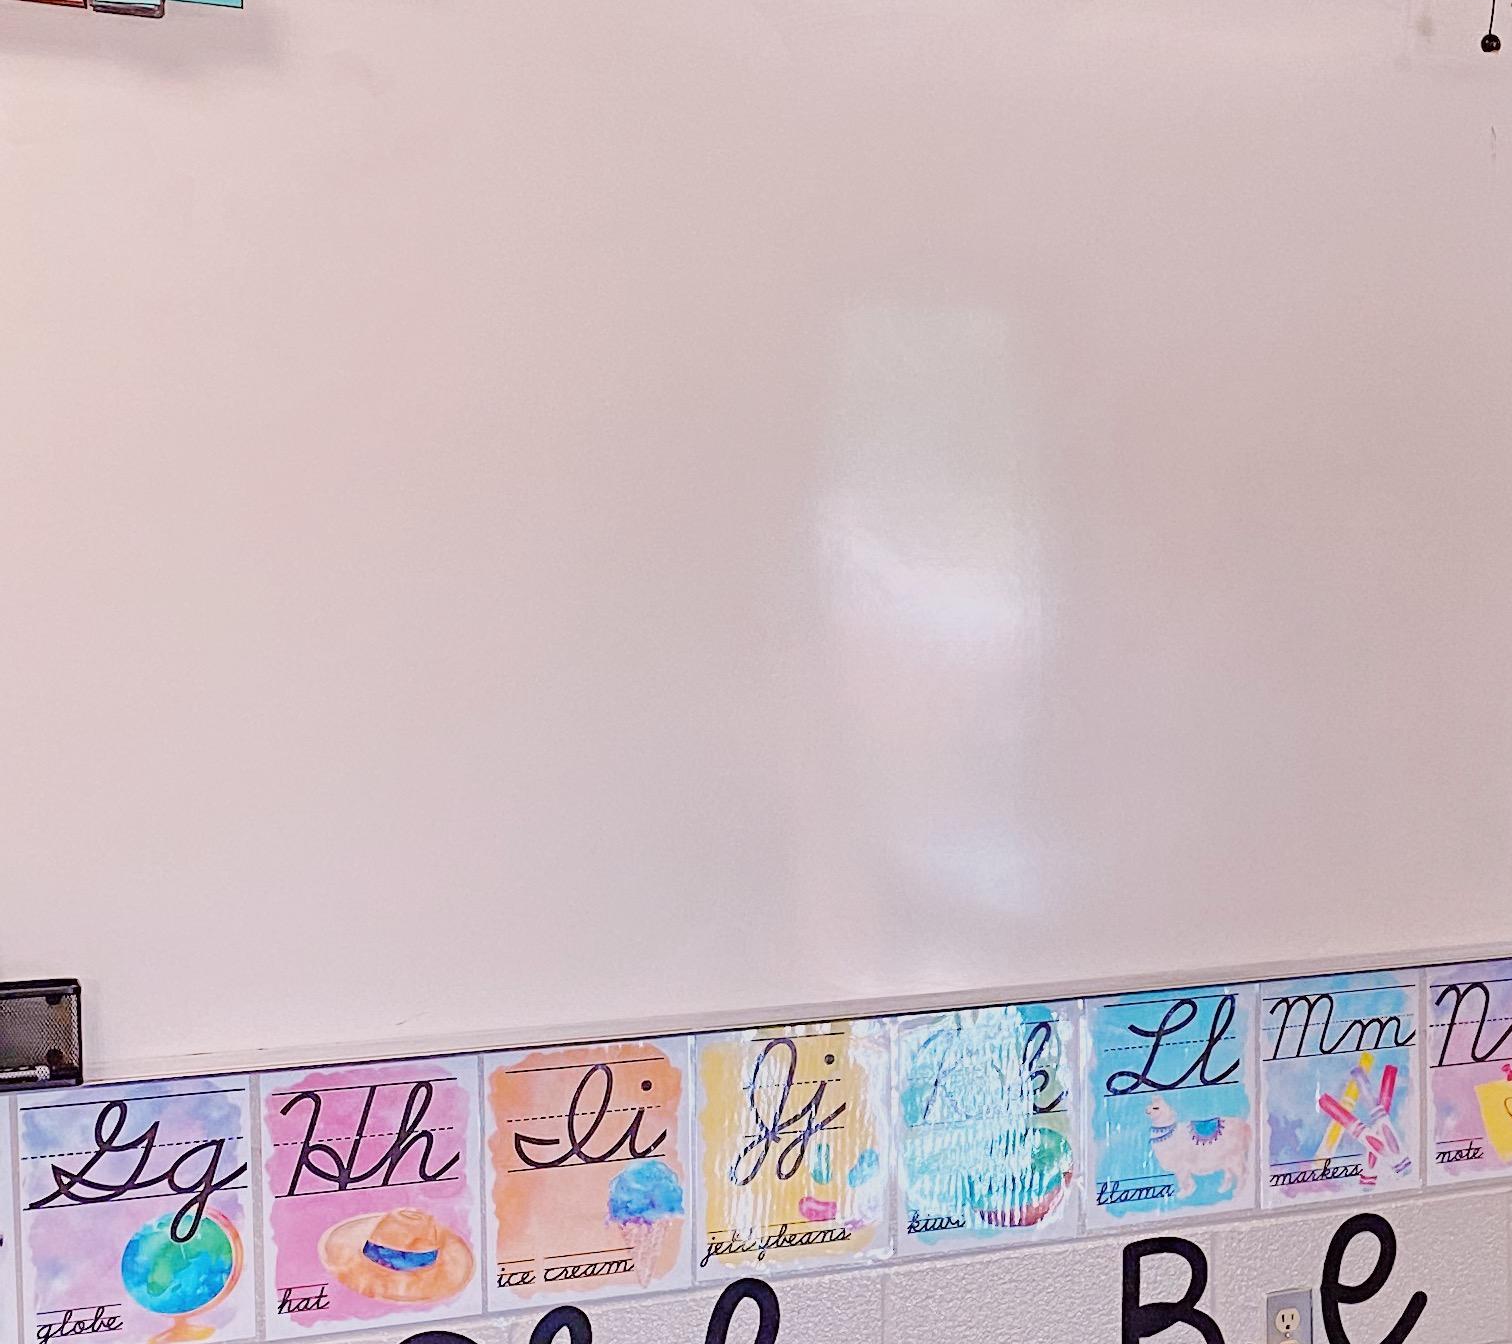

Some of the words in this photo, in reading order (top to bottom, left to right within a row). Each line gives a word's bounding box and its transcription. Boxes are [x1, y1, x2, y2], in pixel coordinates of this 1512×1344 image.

[1270, 993, 1415, 1061] Mm
[1106, 994, 1240, 1095] Ll
[280, 1081, 460, 1197] Hh
[1437, 1144, 1483, 1165] note
[29, 1100, 247, 1243] Gg
[1270, 1161, 1363, 1187] markers
[1097, 1181, 1174, 1206] llama
[908, 1210, 965, 1234] kiwi
[700, 1226, 851, 1267] jellybeans
[497, 1263, 535, 1288] ice
[544, 1258, 634, 1282] cream
[278, 1287, 329, 1314] hat
